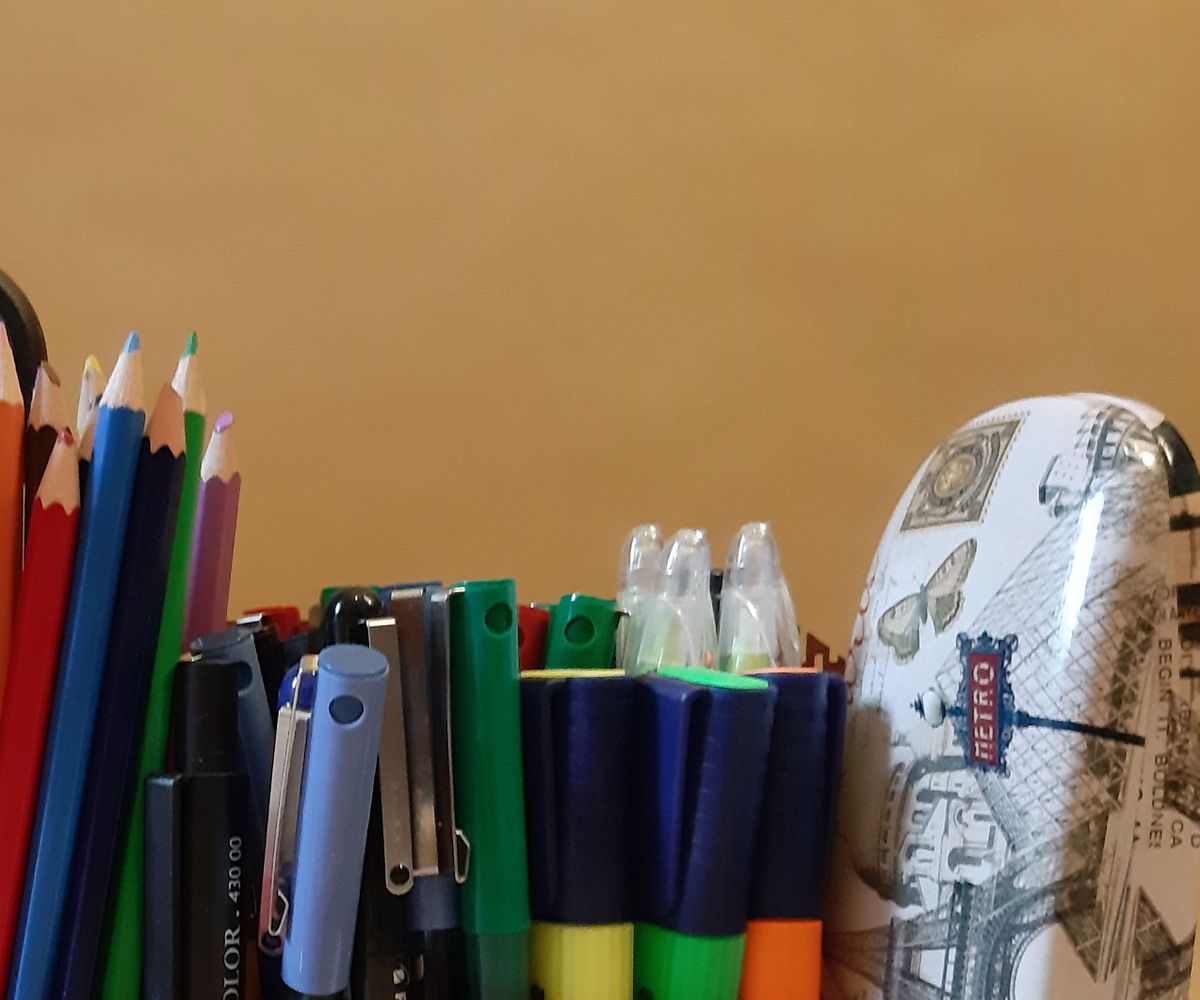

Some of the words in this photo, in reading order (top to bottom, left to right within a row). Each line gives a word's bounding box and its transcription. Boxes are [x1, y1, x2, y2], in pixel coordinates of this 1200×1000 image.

[973, 661, 995, 761] METRO
[229, 835, 243, 862] 00
[228, 865, 242, 903] 430
